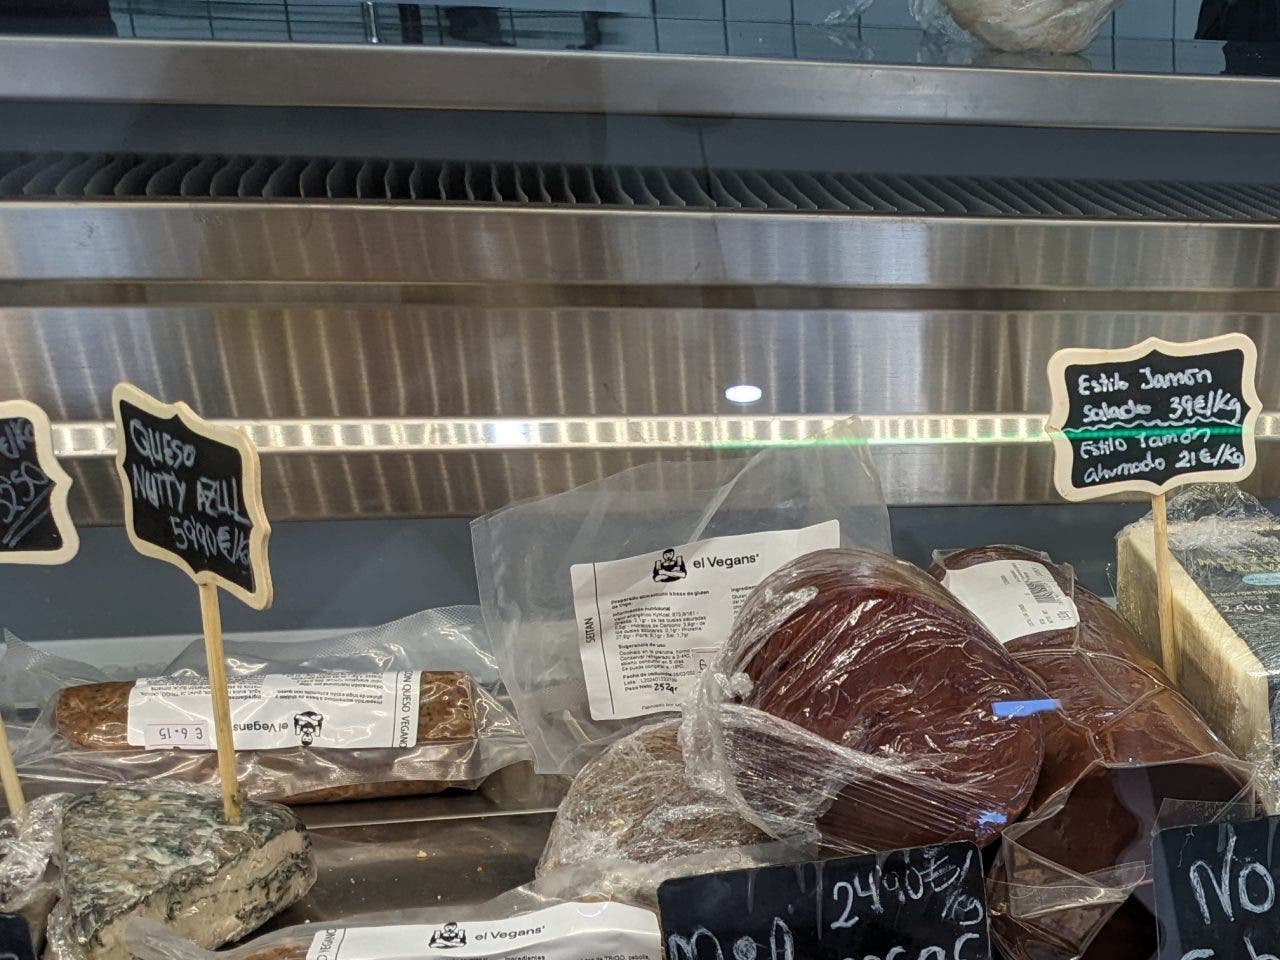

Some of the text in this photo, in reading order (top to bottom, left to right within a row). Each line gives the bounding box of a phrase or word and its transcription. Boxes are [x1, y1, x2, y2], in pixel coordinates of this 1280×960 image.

[1078, 372, 1129, 395] Estilo
[129, 418, 196, 468] QUESO
[1080, 437, 1127, 458] Estilo
[132, 464, 187, 513] NUTTY
[693, 554, 759, 570] el Vegans
[584, 617, 596, 644] SEITAN
[401, 684, 412, 713] QUESO
[491, 926, 545, 940] Vegans
